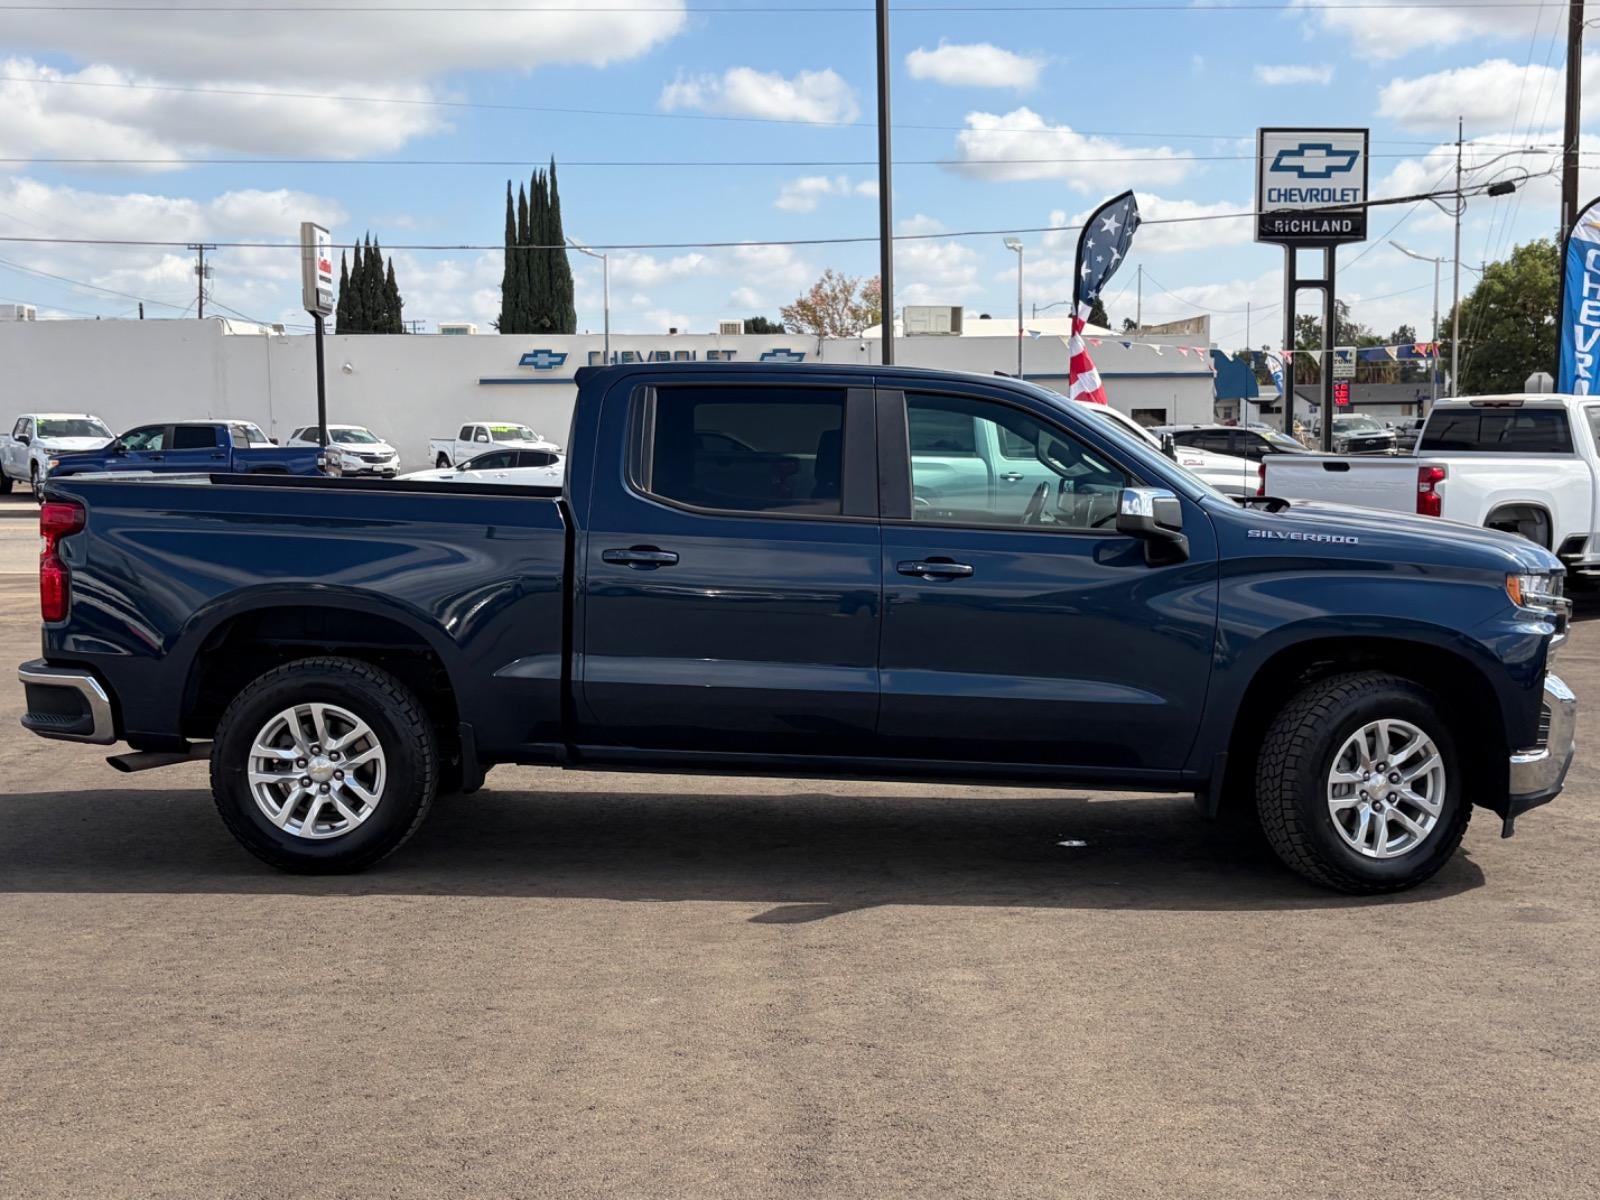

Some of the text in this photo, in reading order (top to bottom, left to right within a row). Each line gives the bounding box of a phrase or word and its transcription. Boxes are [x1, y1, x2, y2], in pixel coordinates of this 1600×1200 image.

[1268, 188, 1360, 203] CHEVROLET
[1275, 220, 1352, 232] RICHLAND
[1247, 529, 1359, 545] SILVERADO
